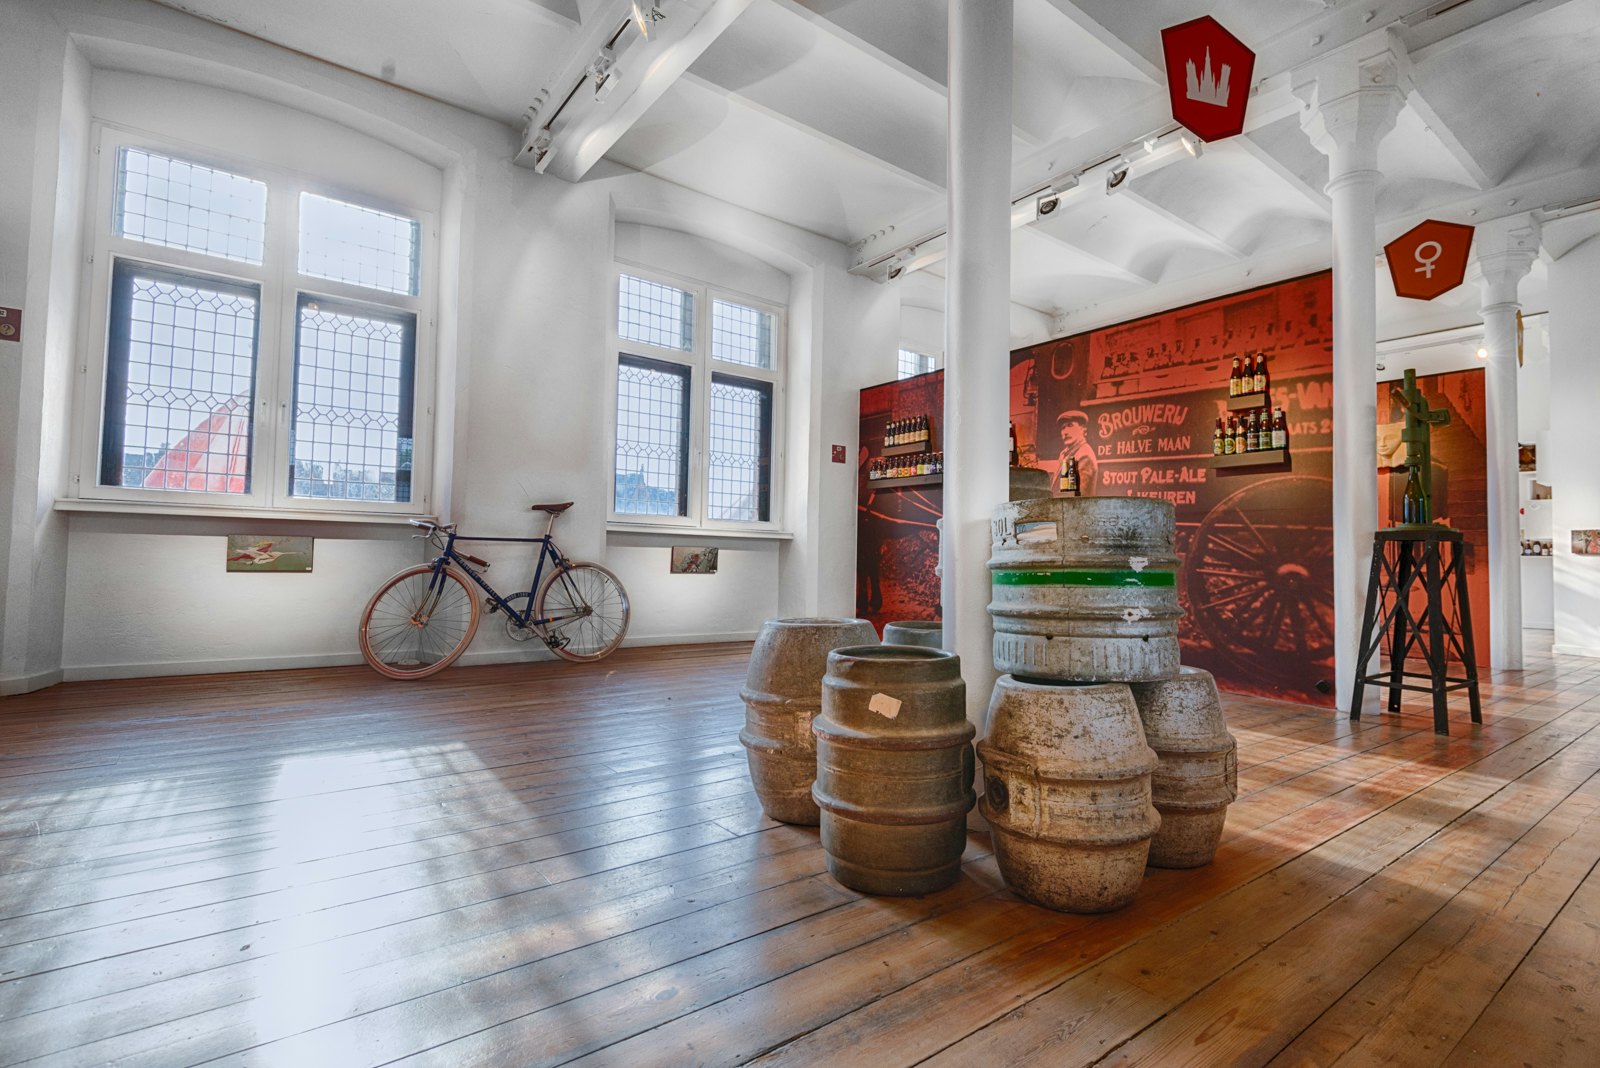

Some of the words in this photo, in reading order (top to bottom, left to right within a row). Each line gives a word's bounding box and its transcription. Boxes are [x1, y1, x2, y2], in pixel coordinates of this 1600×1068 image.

[1097, 403, 1189, 438] BROUWERIJ
[1097, 444, 1112, 456] DE
[1116, 438, 1153, 455] HALVE
[1157, 435, 1191, 452] MAAN
[1102, 470, 1138, 485] STOUT
[1140, 466, 1207, 484] PALE-ALE
